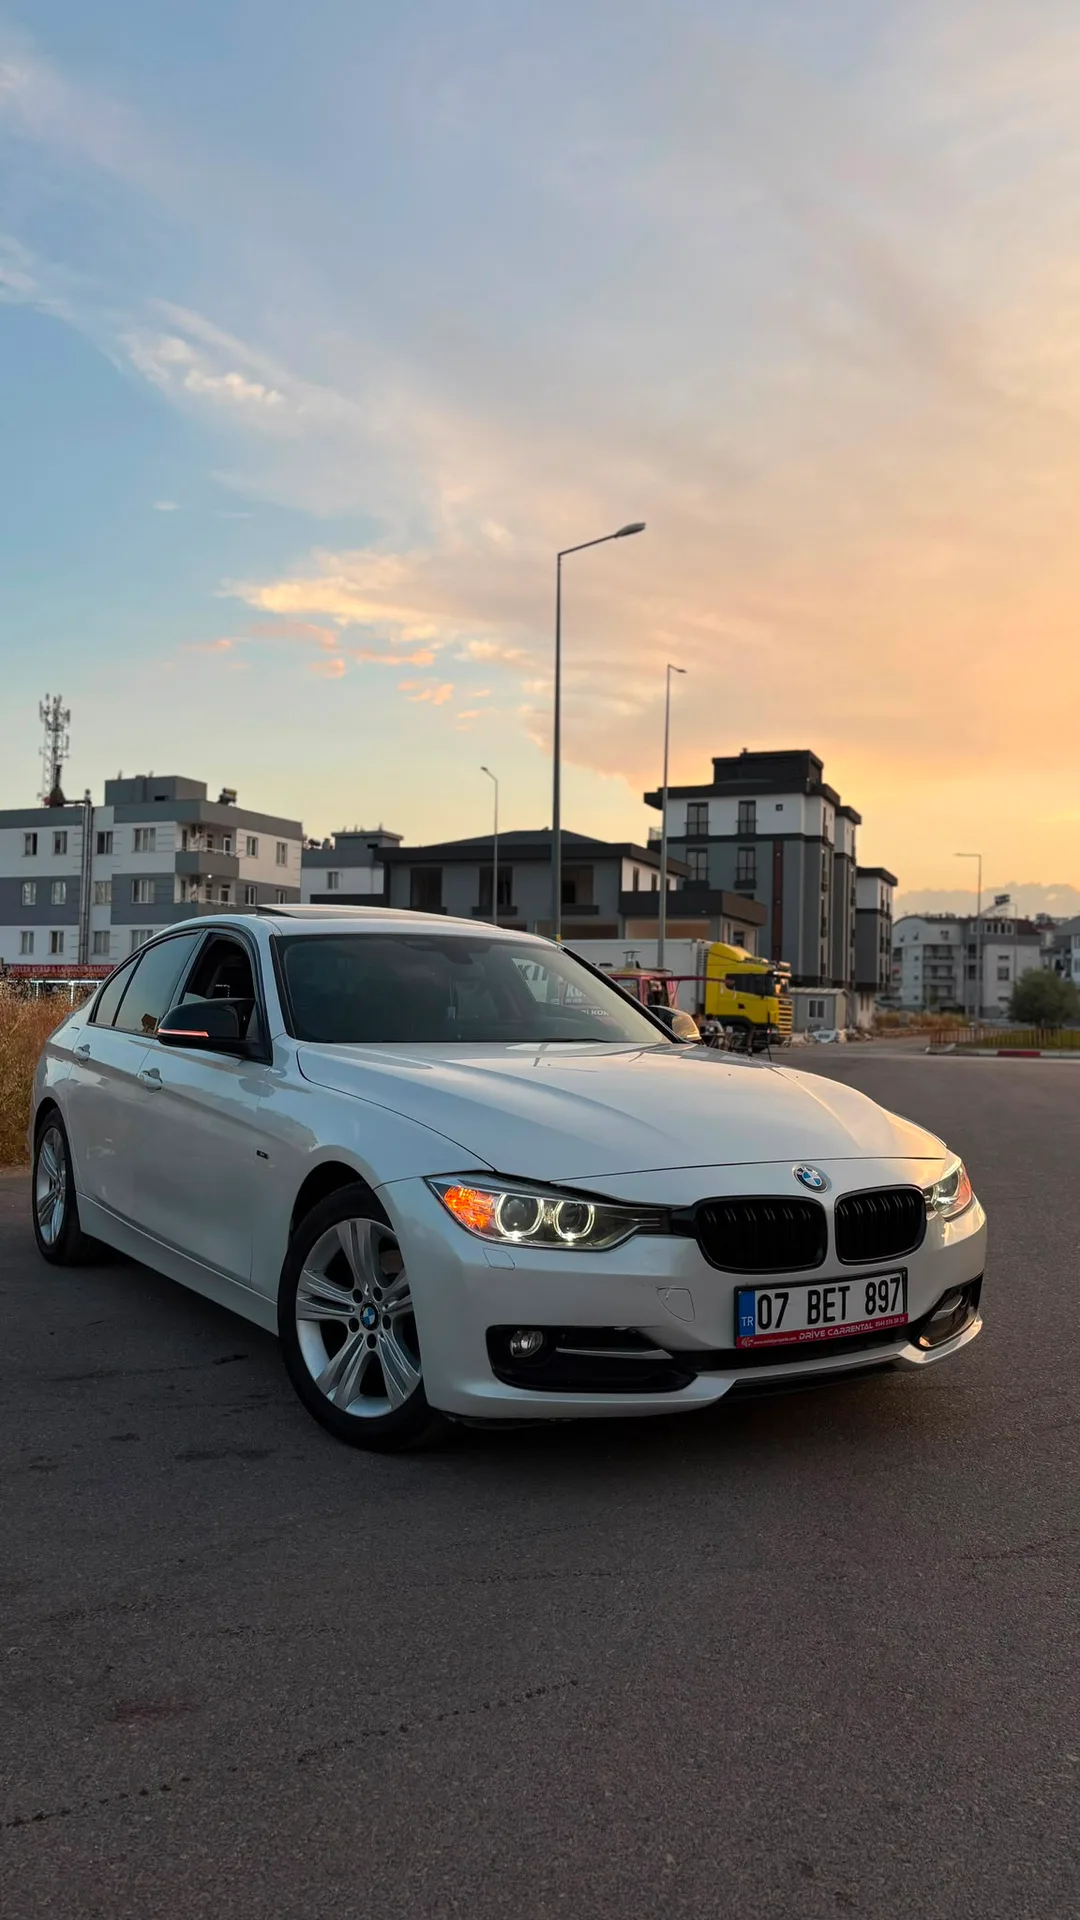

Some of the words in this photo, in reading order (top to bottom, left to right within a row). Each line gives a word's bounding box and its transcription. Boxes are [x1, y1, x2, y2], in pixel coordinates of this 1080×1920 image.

[757, 1292, 789, 1330] 07
[807, 1286, 850, 1325] BET
[865, 1277, 901, 1316] 897
[741, 1316, 754, 1327] TR
[827, 1322, 874, 1336] CARRENTAL
